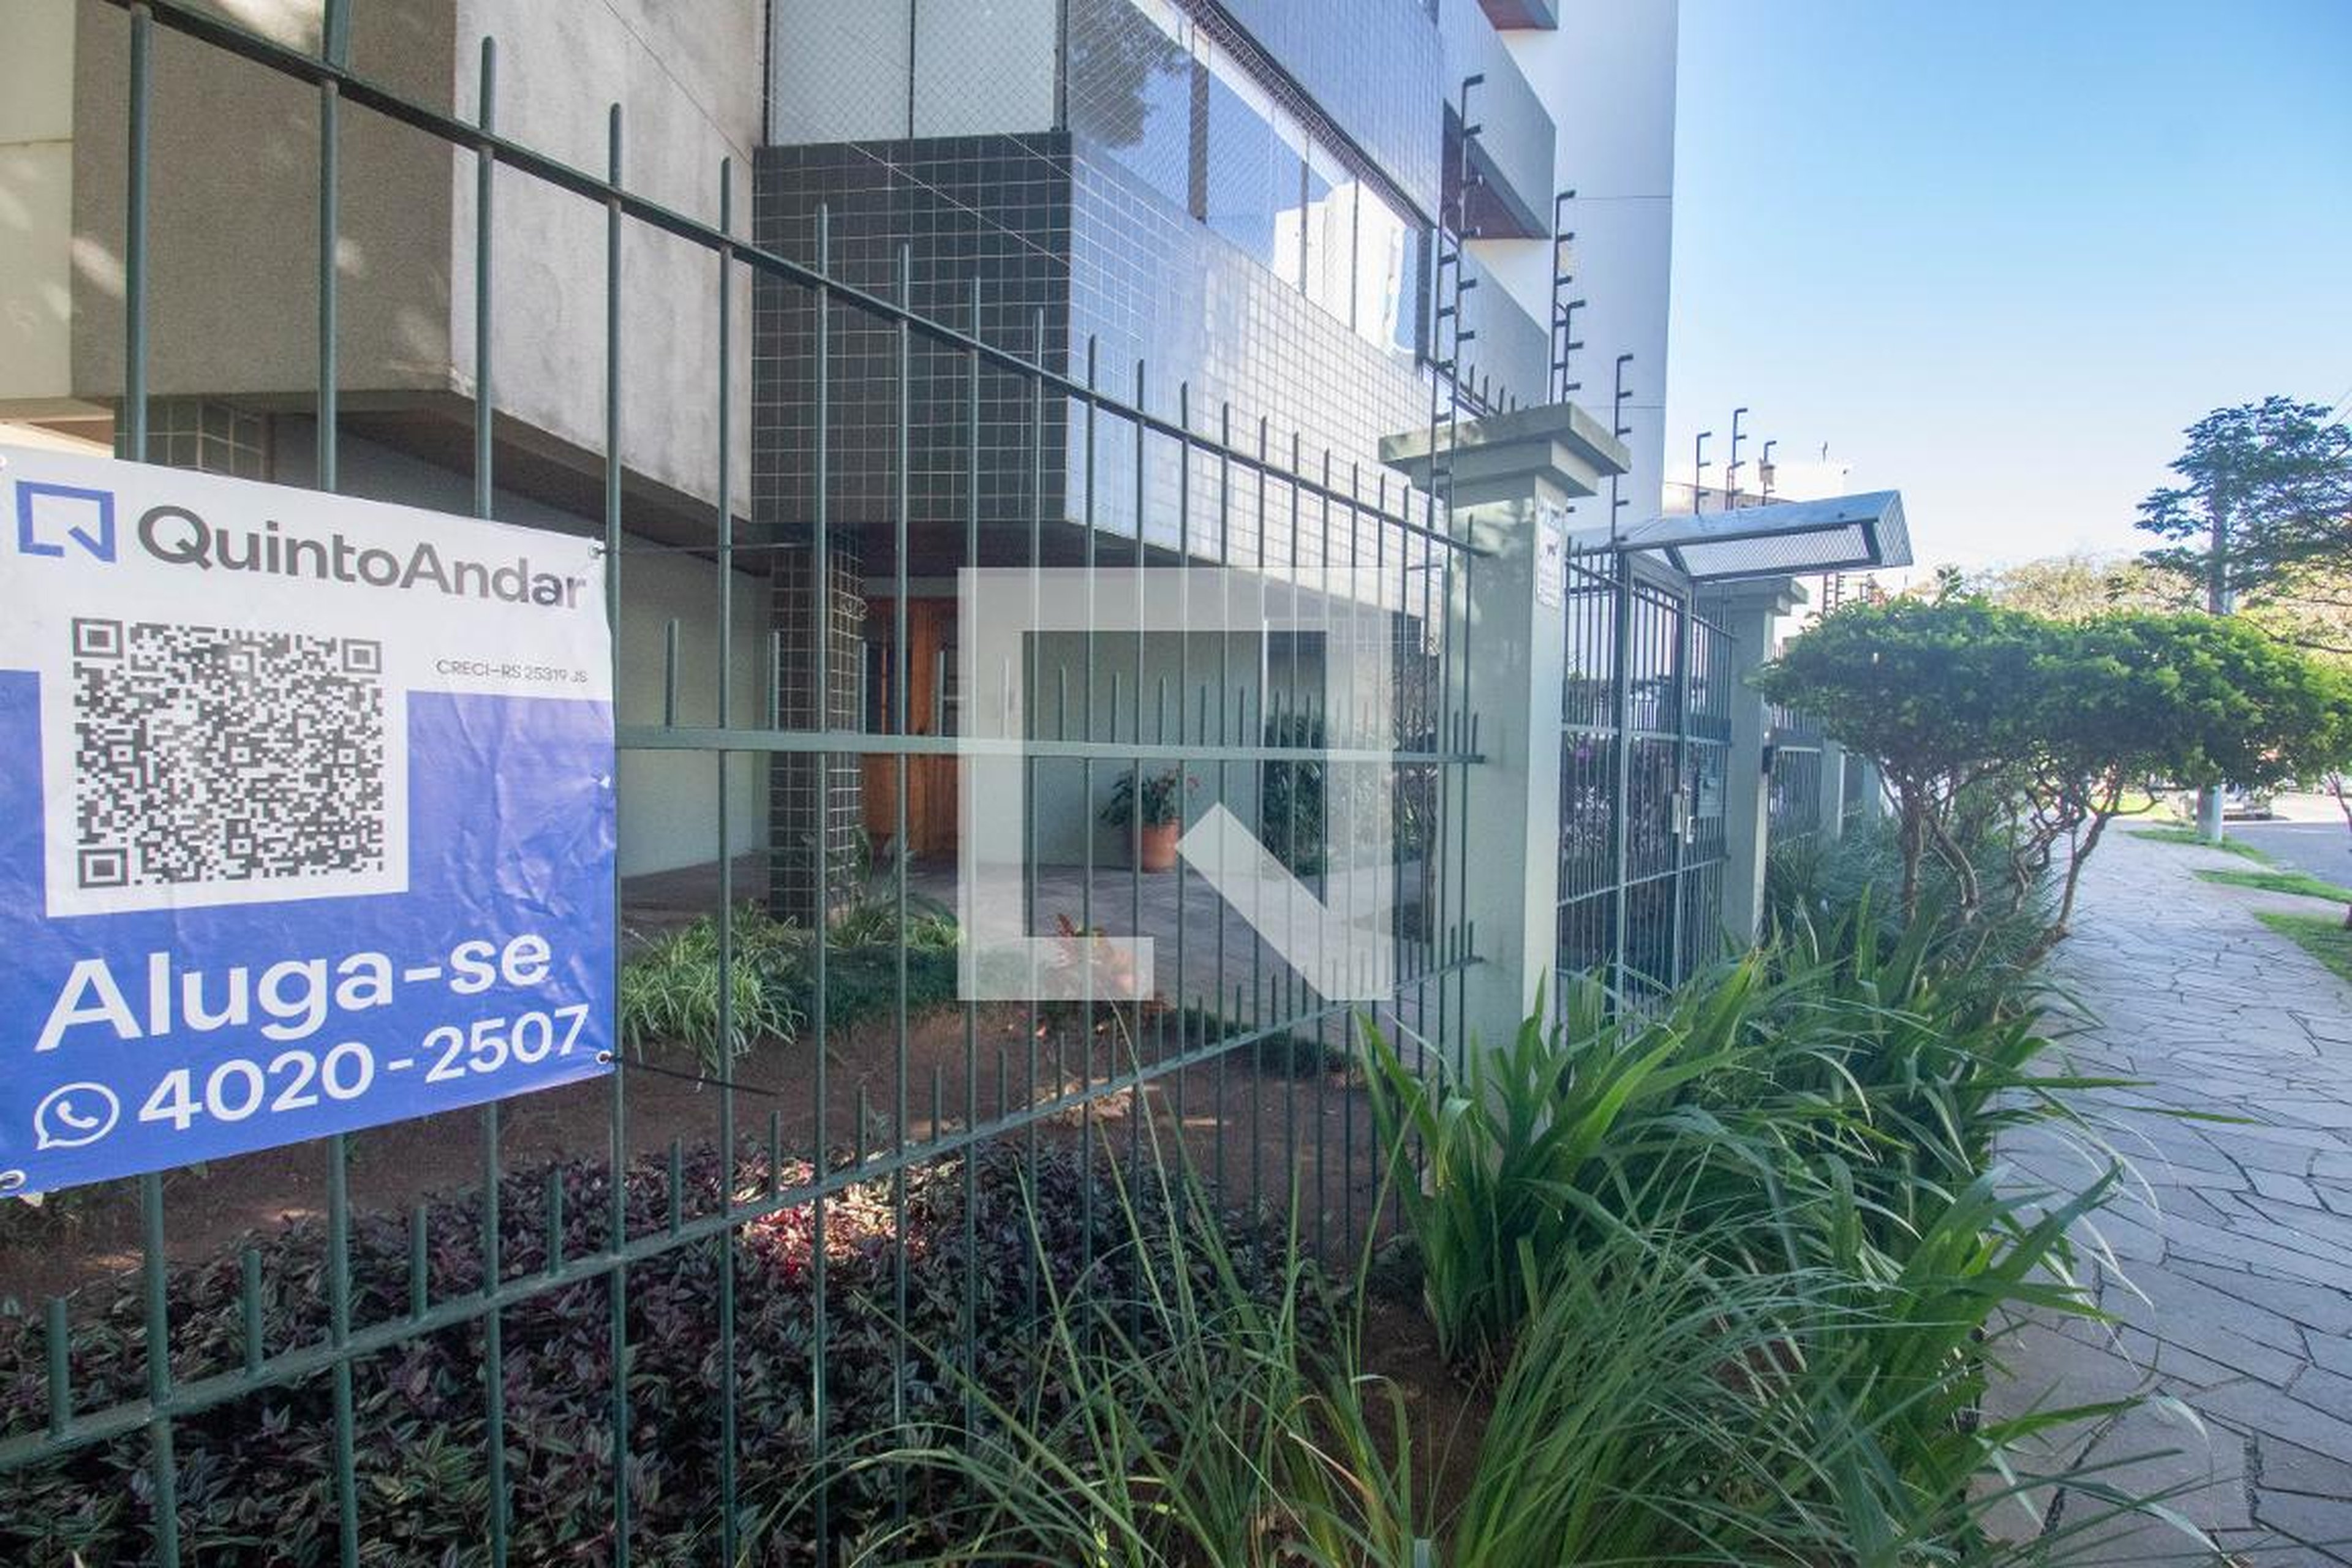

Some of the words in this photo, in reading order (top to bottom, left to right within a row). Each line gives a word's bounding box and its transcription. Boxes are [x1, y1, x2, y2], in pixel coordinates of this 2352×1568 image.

[138, 505, 587, 608] QuintoAndar
[437, 659, 521, 679] CRECI-RS
[34, 933, 552, 1052] Aluga-se
